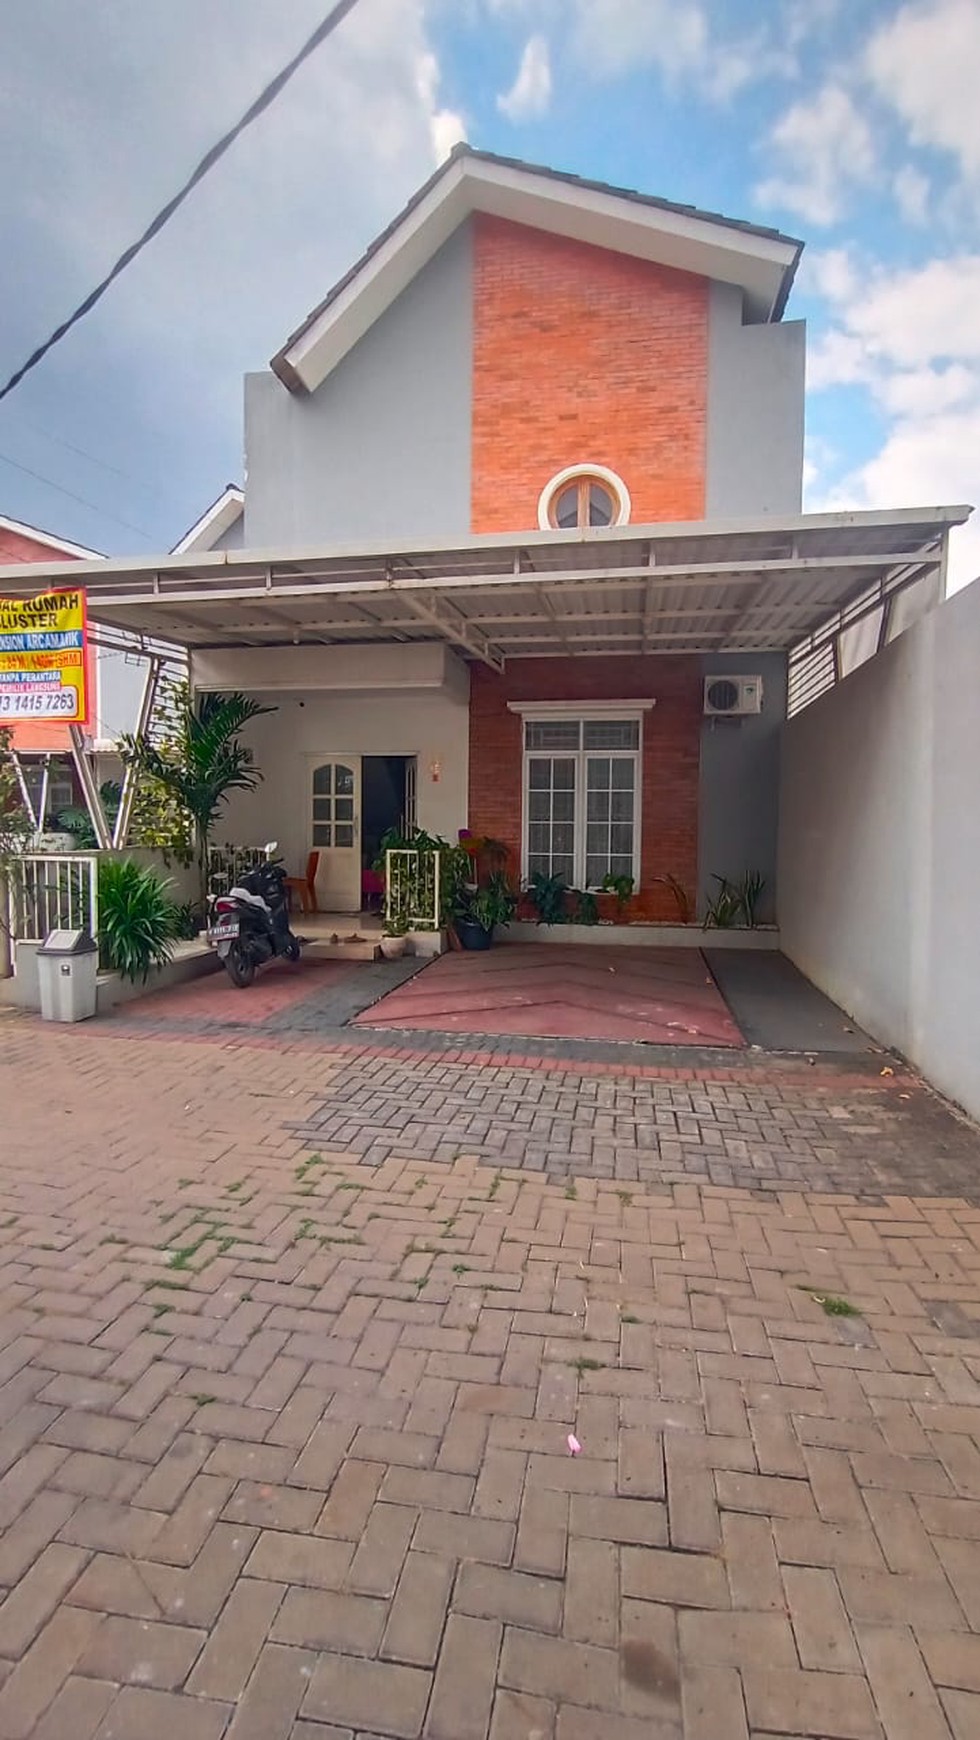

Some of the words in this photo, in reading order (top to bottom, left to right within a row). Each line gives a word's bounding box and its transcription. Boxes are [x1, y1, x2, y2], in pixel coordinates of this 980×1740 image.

[0, 600, 18, 612] AL
[23, 594, 79, 612] RUMAH
[0, 613, 58, 629] LUSTER
[15, 695, 42, 711] 1415
[46, 693, 74, 710] 7263
